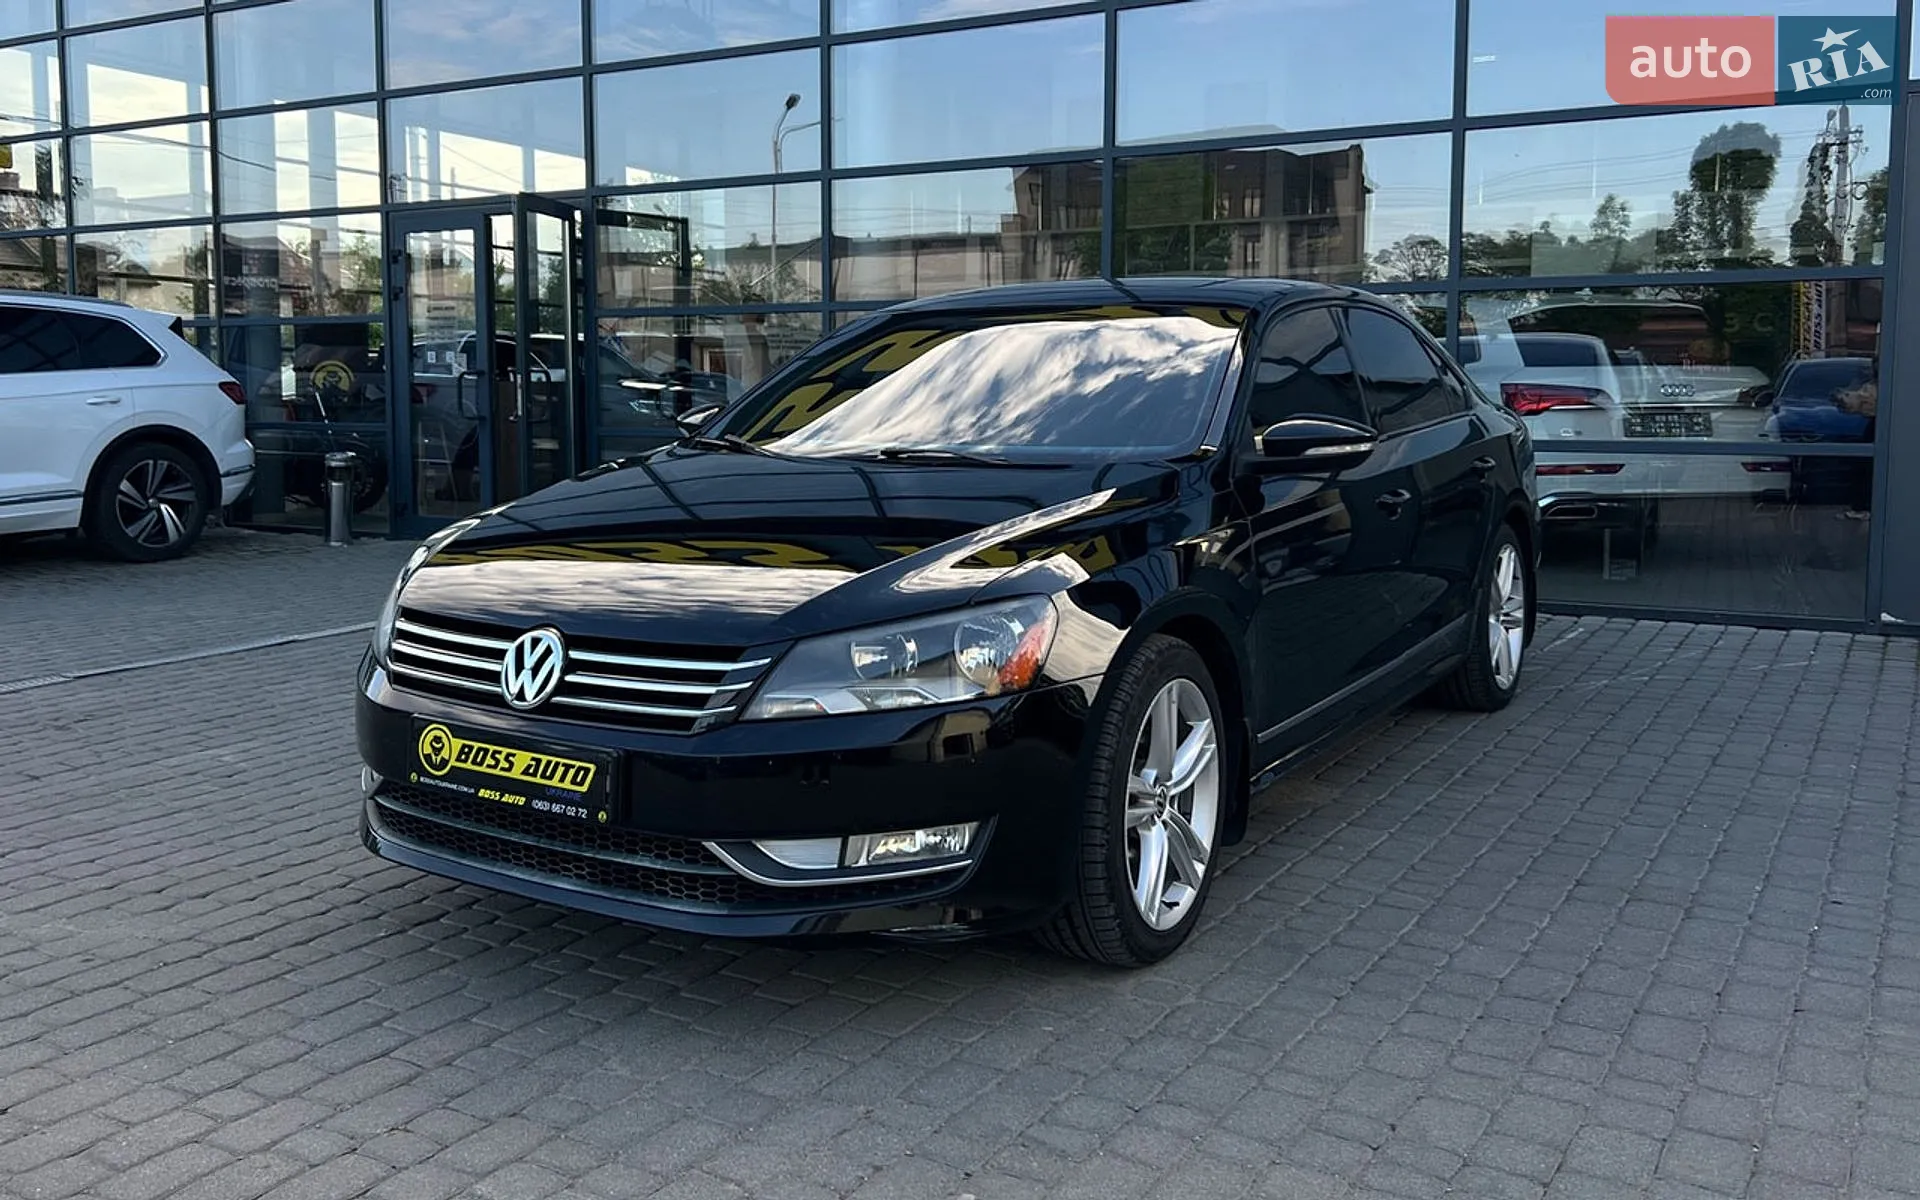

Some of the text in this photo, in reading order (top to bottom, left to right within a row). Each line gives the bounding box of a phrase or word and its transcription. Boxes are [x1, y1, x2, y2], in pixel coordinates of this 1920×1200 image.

[455, 743, 592, 787] BOSS AUTO
[477, 788, 527, 806] BOSS AUTO
[577, 807, 588, 819] 72
